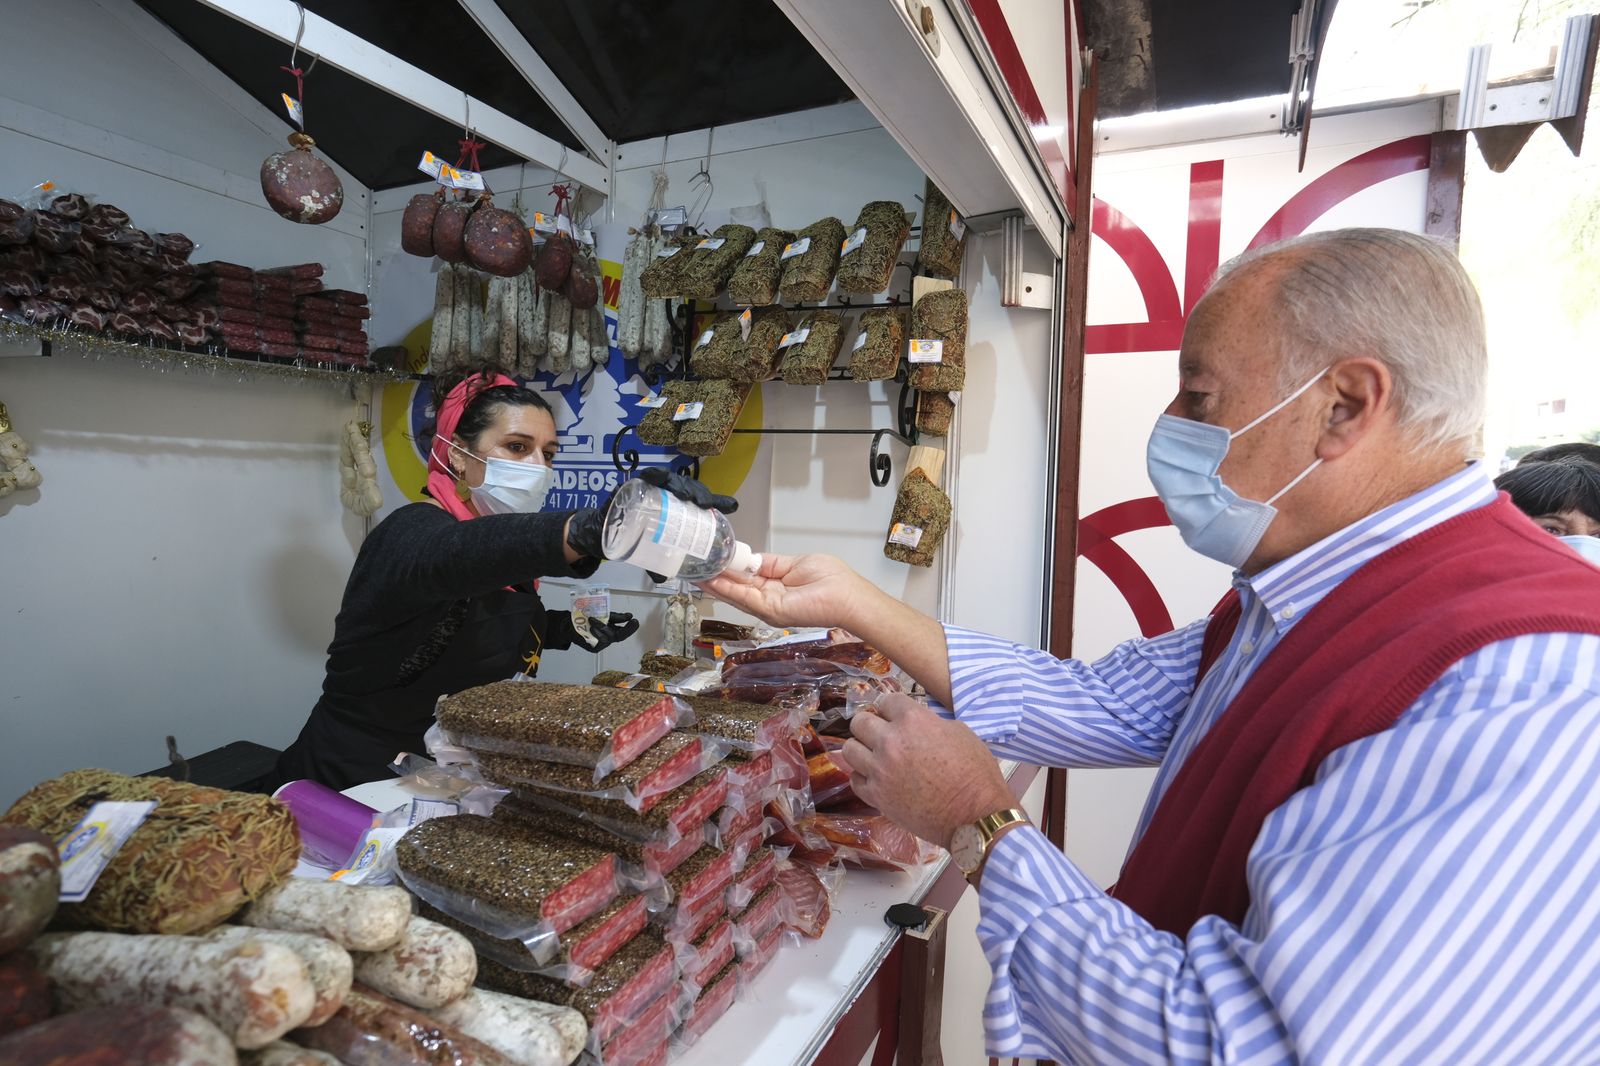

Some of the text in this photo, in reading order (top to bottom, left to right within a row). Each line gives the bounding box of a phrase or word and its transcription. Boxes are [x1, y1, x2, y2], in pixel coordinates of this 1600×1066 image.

[407, 345, 430, 374] Ind
[552, 470, 619, 493] ADEOS
[549, 493, 560, 509] 41
[566, 493, 579, 510] 71
[583, 494, 598, 510] 78
